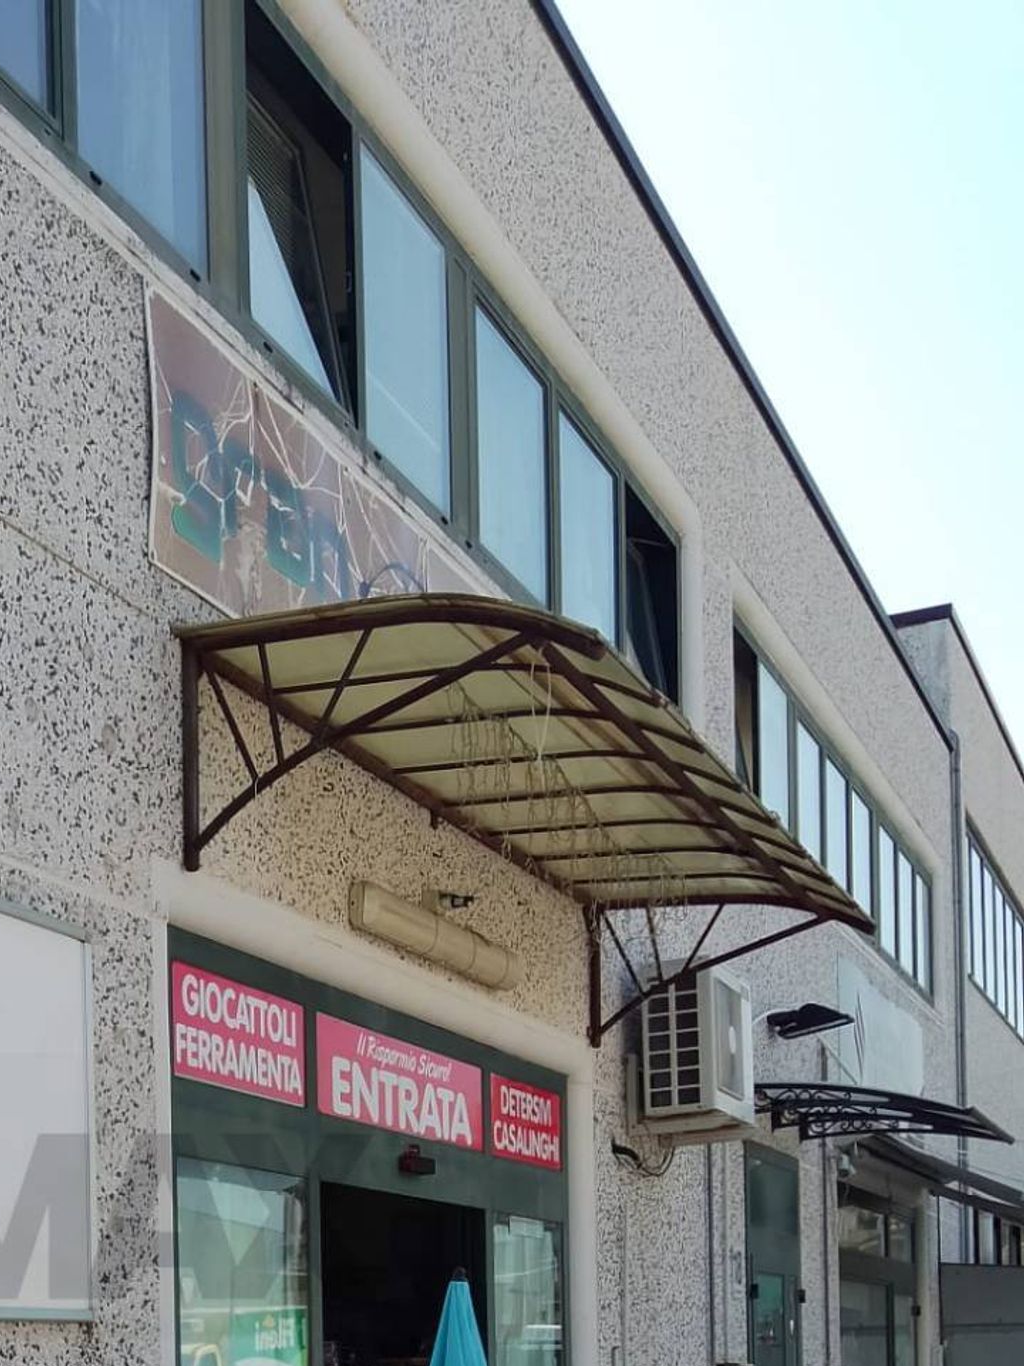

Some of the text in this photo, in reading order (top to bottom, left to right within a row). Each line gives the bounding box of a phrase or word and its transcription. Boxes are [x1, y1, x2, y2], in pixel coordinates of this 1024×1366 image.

[181, 974, 297, 1047] GIOCATTOLI
[176, 1022, 303, 1097] FERRAMENTA
[367, 1036, 417, 1072] Risparmio
[331, 1056, 473, 1147] ENTRATA
[493, 1120, 560, 1162] CASALINGHI
